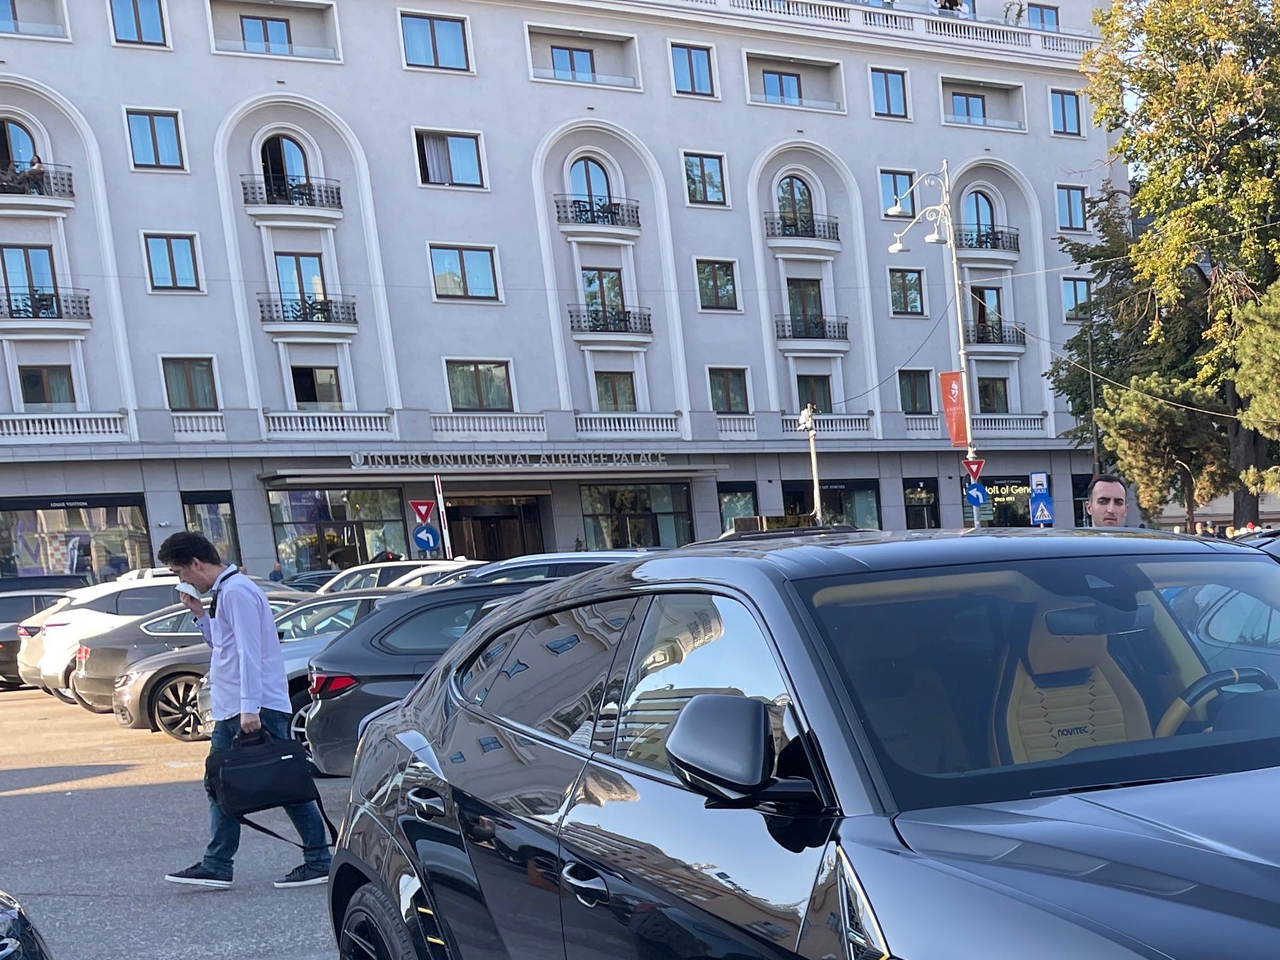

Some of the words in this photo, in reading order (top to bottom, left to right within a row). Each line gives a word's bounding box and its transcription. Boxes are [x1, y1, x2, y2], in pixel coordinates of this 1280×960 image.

[367, 452, 533, 468] INTERCONTINENTAL
[539, 449, 608, 467] ATHÉNÉE
[612, 452, 667, 466] PALACE
[1010, 485, 1031, 494] Gene
